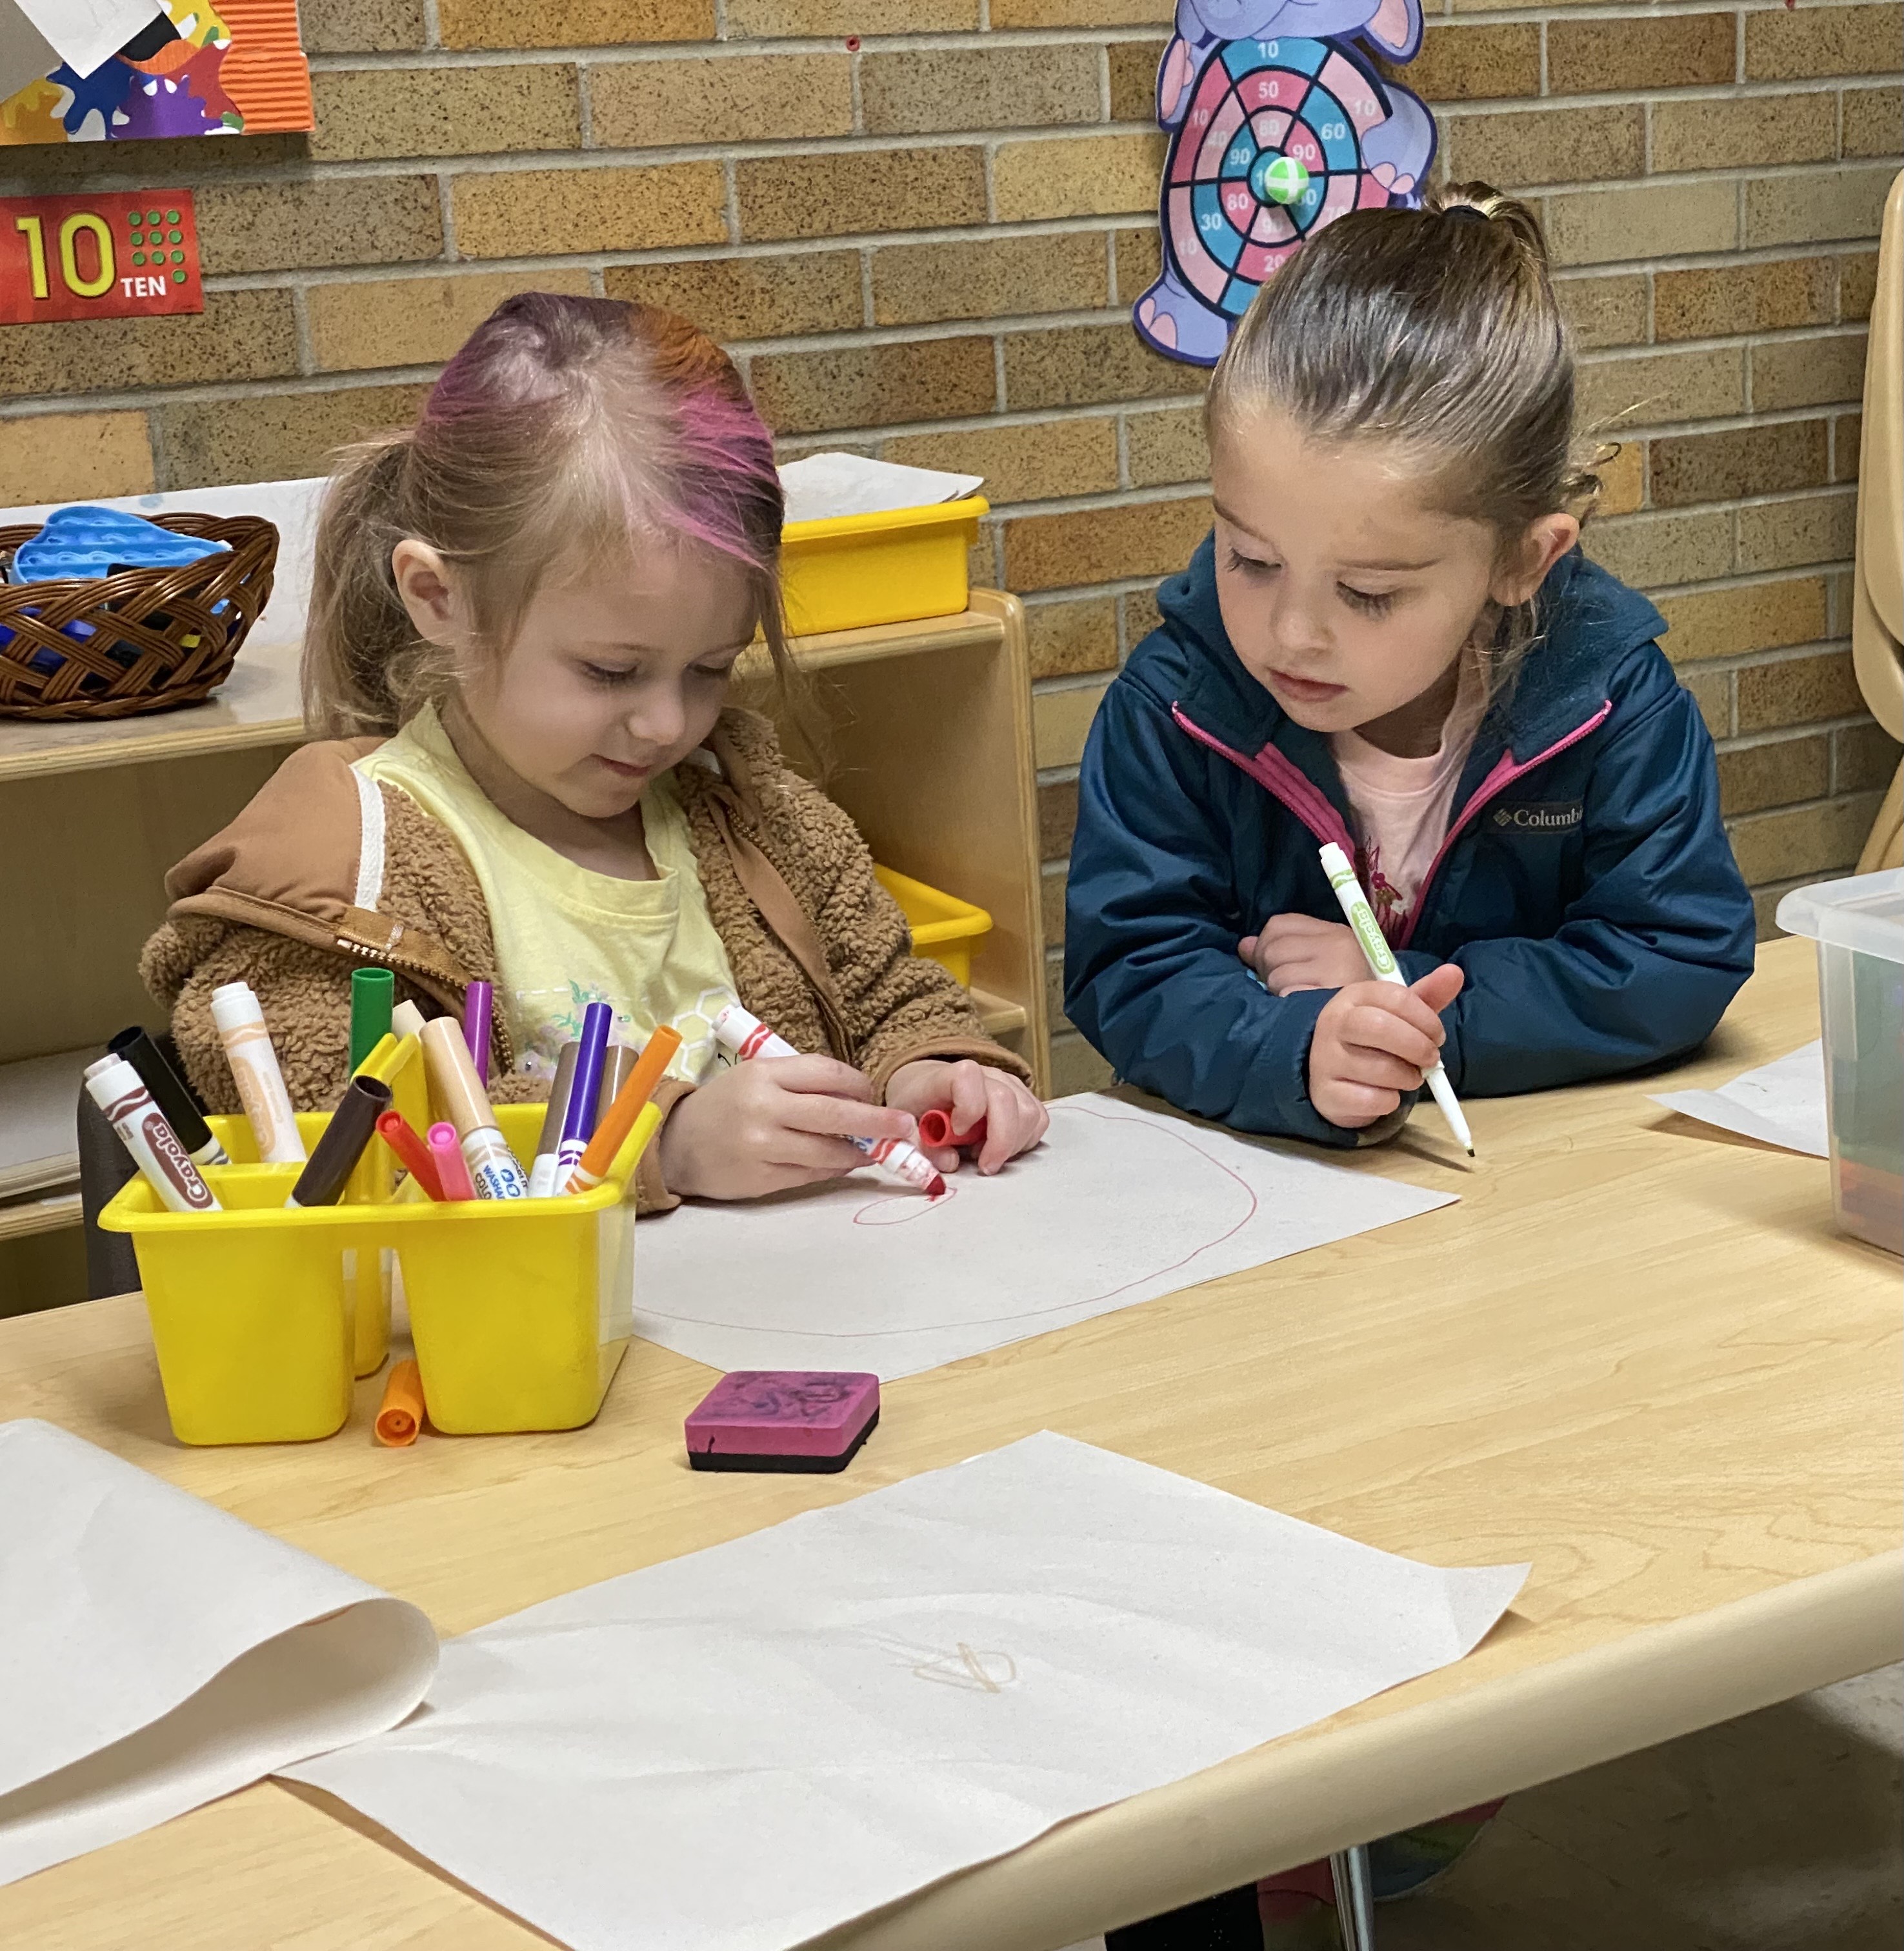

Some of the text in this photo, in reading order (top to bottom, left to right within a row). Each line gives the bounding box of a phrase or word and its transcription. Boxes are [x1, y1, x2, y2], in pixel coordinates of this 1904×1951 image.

[1258, 41, 1279, 59] 10
[1258, 81, 1279, 99] 50
[1193, 108, 1209, 126] 10
[1354, 99, 1376, 117] 10
[1321, 123, 1345, 141] 60
[1230, 148, 1251, 166] 90
[1292, 143, 1316, 161] 90
[1201, 212, 1222, 230] 30
[15, 210, 117, 301] 10
[1177, 237, 1198, 256] 10
[121, 275, 166, 298] TEN
[1357, 908, 1392, 970] Crayola
[153, 1122, 208, 1201] Crayola
